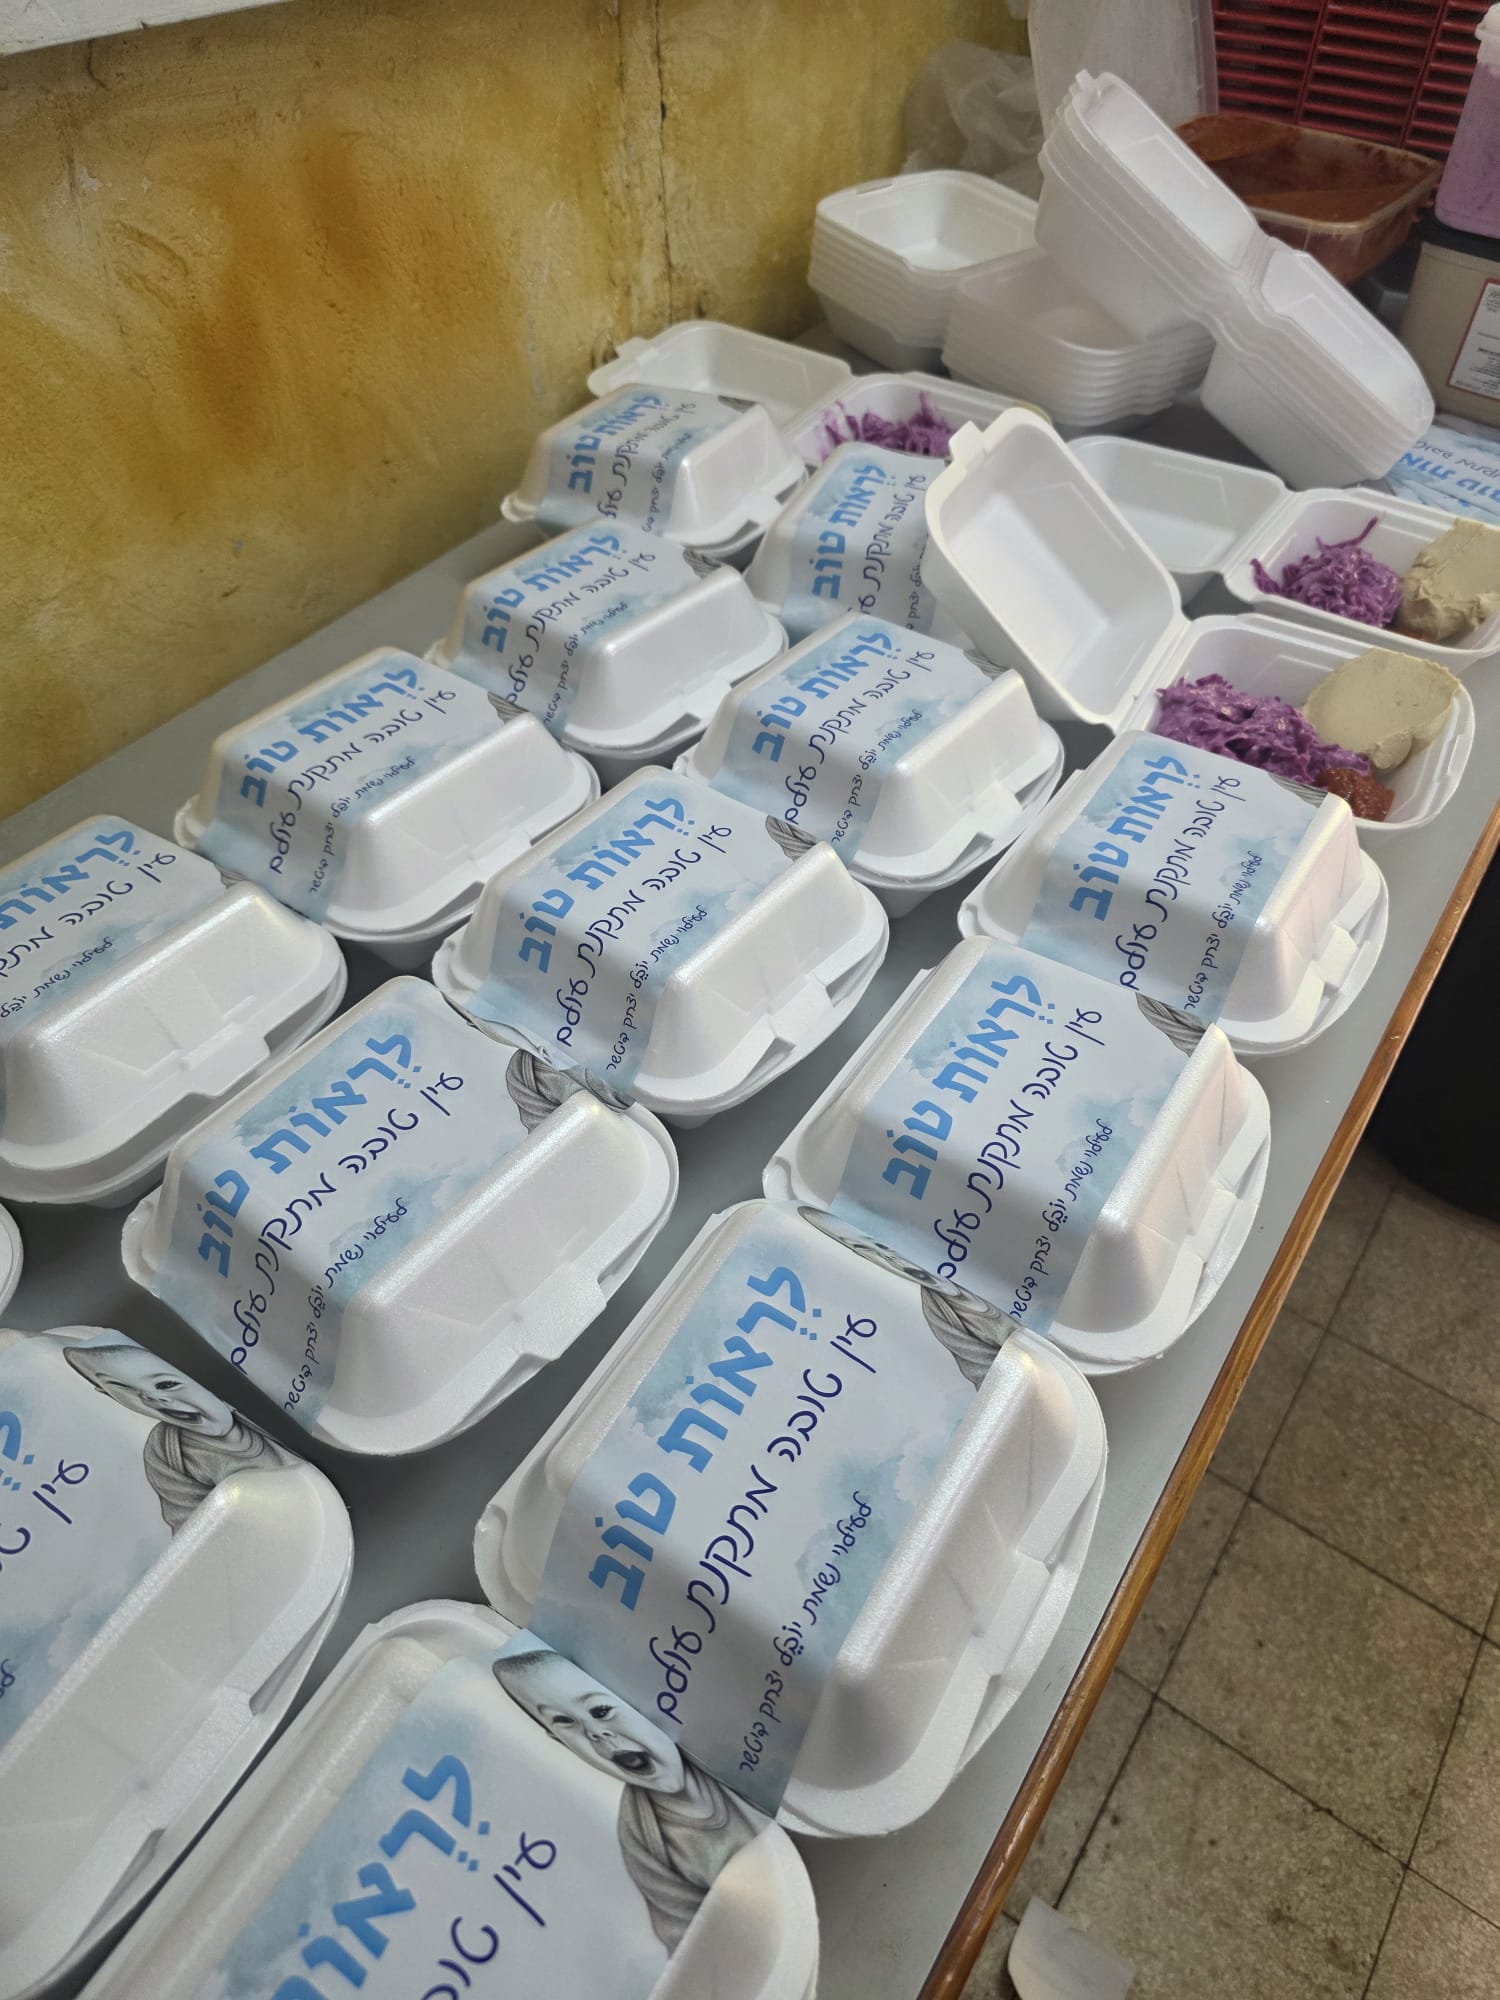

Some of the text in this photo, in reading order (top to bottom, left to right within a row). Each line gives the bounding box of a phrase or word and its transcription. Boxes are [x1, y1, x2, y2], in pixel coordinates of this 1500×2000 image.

[612, 431, 648, 487] מתקנת
[597, 488, 622, 519] עול
[884, 493, 914, 521] טובה
[628, 553, 656, 572] עין
[862, 522, 894, 592] מתקנת
[579, 566, 630, 594] טובה
[526, 591, 581, 652] מתקנת
[558, 660, 570, 691] יצחק
[784, 650, 935, 826] עין טובה מתקנת עולם
[878, 730, 902, 752] נשמת
[900, 708, 923, 733] לעילוי
[268, 690, 456, 874] עין טובה מתקנת עולם
[384, 756, 416, 780] לעילוי
[354, 778, 384, 800] נשמת
[848, 774, 863, 808] יצחק
[323, 822, 335, 856] יצחק
[137, 853, 176, 883] עין
[1115, 776, 1246, 991] עין טובה מתקנת עולם
[1242, 851, 1263, 878] לעילוי
[58, 880, 133, 926] טובה
[1229, 877, 1251, 905] נשמת
[556, 824, 732, 1047] עין טובה מתקנת עולם
[676, 905, 707, 936] לעילוי
[72, 936, 113, 968] לעילוי
[650, 934, 680, 963] נשמת
[1201, 933, 1221, 969] יצחק
[34, 969, 70, 999] נשמת
[623, 993, 636, 1029] יצחק
[1064, 1007, 1105, 1046] עין
[1022, 1041, 1078, 1100] טובה
[966, 1099, 1034, 1213] מתקנת
[1077, 1118, 1113, 1160] לעילוי
[1062, 1159, 1093, 1201] נשמת
[231, 1072, 464, 1375] עין טובה מתקנת עולם
[365, 1197, 408, 1242] לעילוי
[326, 1244, 364, 1289] נשמת
[1030, 1235, 1051, 1275] יצחק
[303, 1321, 316, 1366] יצחק
[32, 1459, 89, 1524] עין
[648, 1314, 878, 1725] עין טובה מתקנת עולם
[832, 1491, 873, 1556] לעילוי
[803, 1558, 842, 1626] נשמת
[758, 1671, 783, 1723] יצחק
[421, 1832, 556, 2000] עין טו
